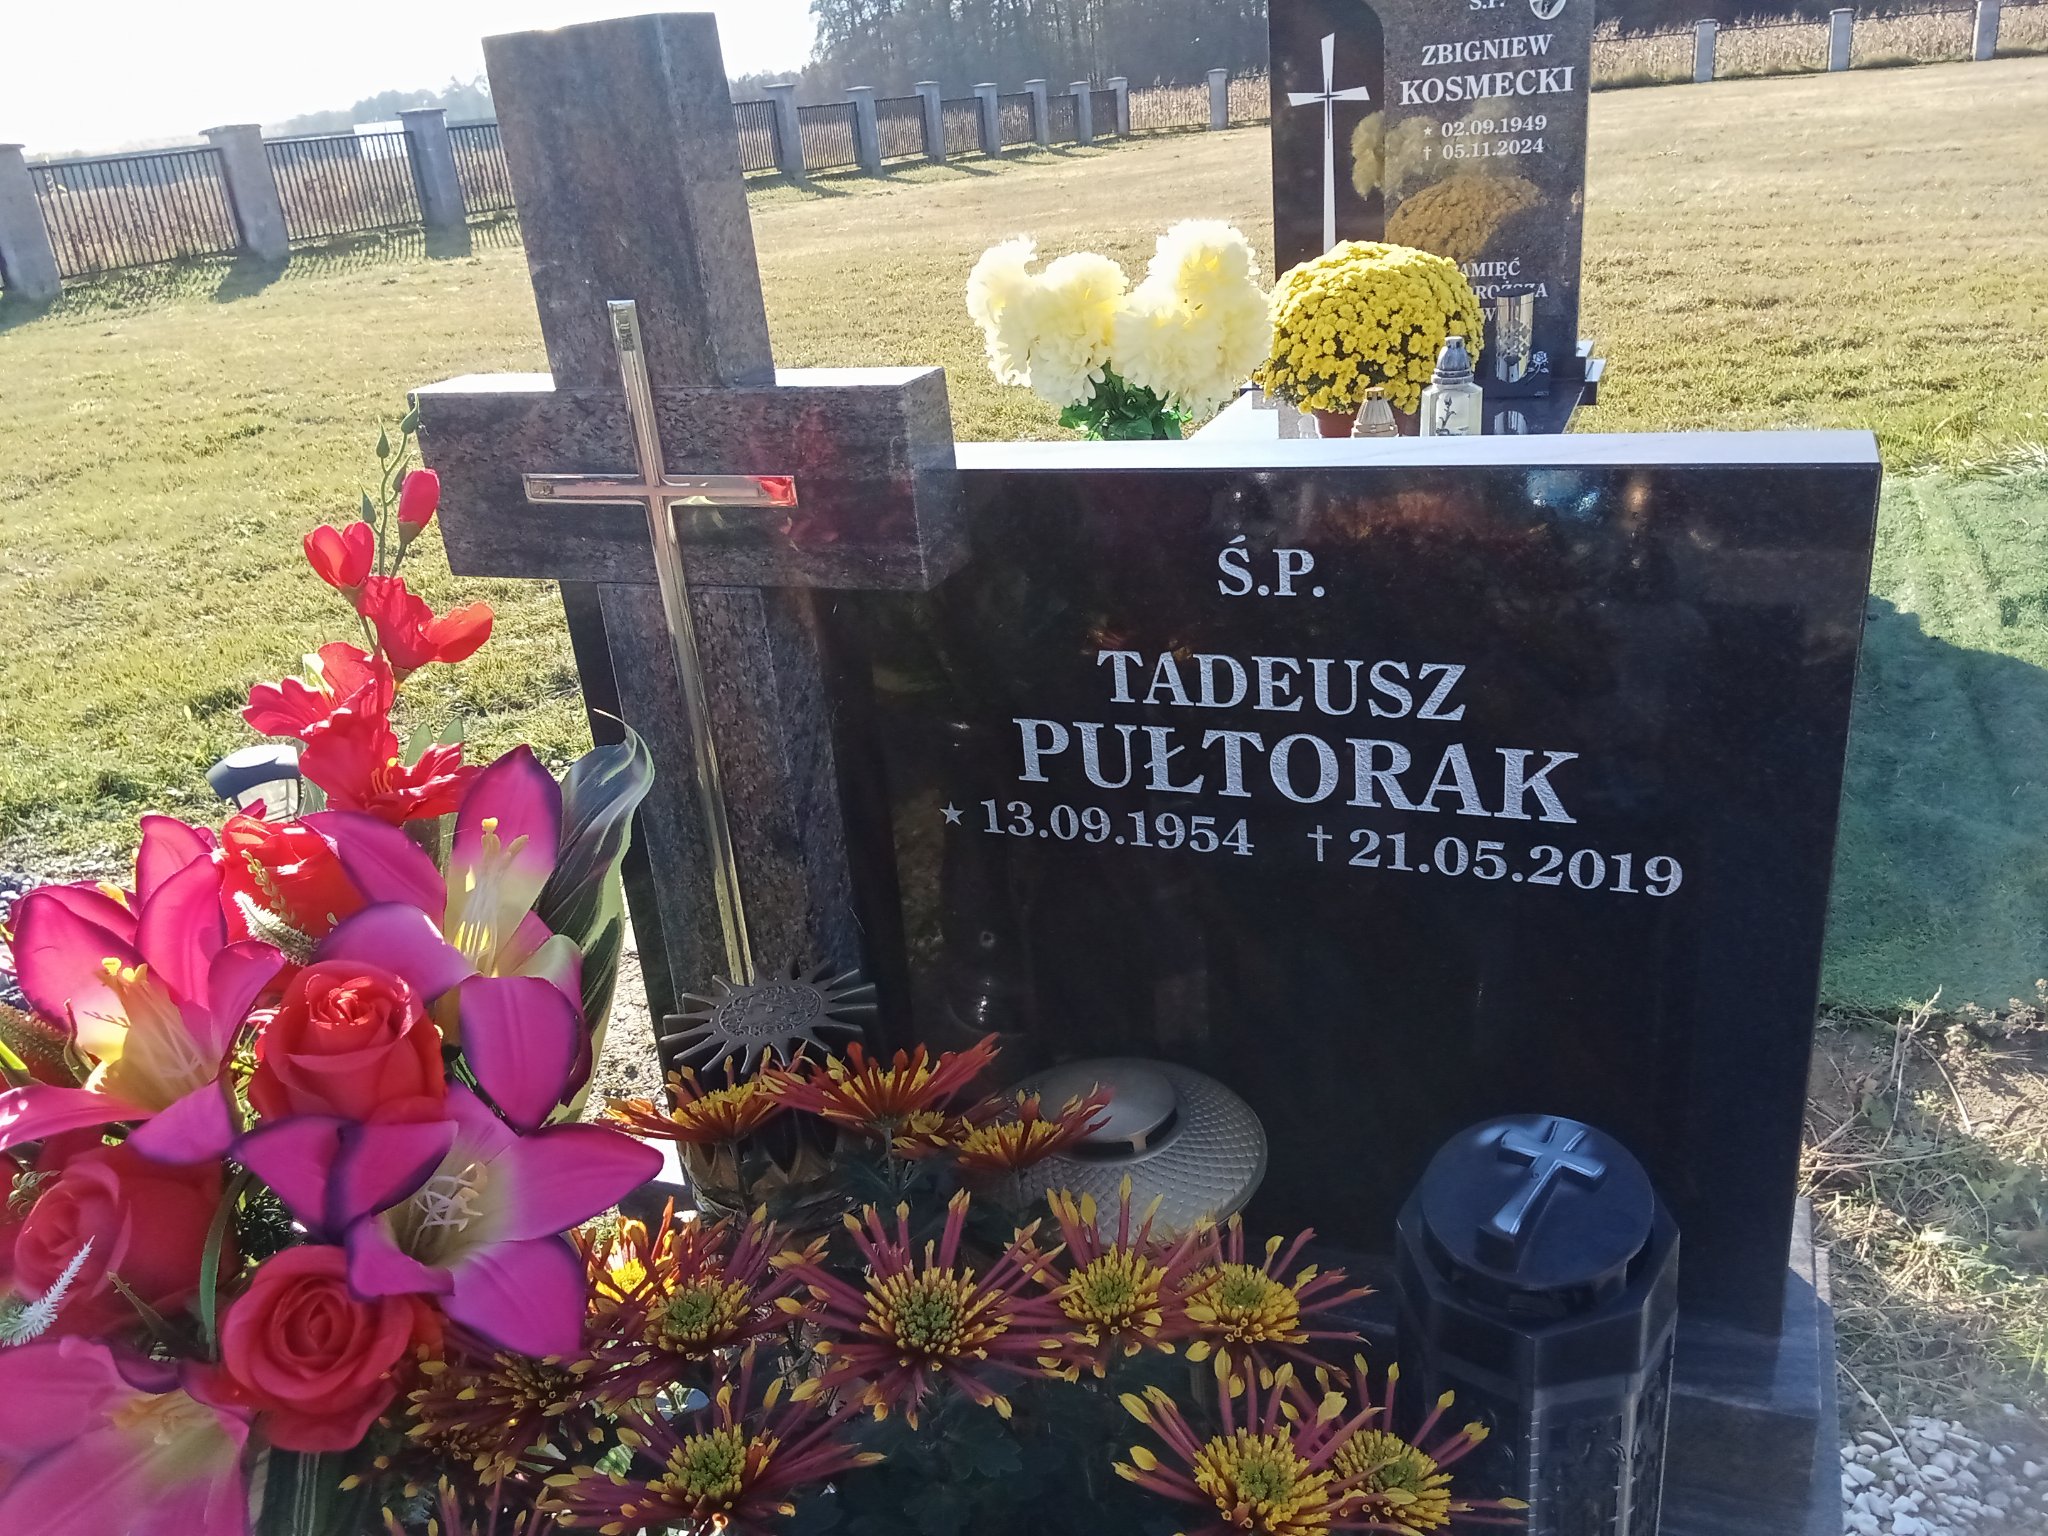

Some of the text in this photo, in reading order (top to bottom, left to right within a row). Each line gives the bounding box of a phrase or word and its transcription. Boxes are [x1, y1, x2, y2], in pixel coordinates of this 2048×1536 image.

[1421, 33, 1553, 66] ZBIGNIEW
[1398, 66, 1575, 106] KOSMECKI
[1441, 114, 1547, 138] 02.09.1949
[1442, 137, 1544, 160] 05.11.2024
[1460, 256, 1521, 280] AMIĘĆ
[1217, 534, 1326, 598] Ś.P.
[1096, 650, 1467, 721] TADEUSZ
[1012, 717, 1579, 824] PUŁTORAK
[980, 799, 1684, 897] 13.09.1954 21.05.2019
